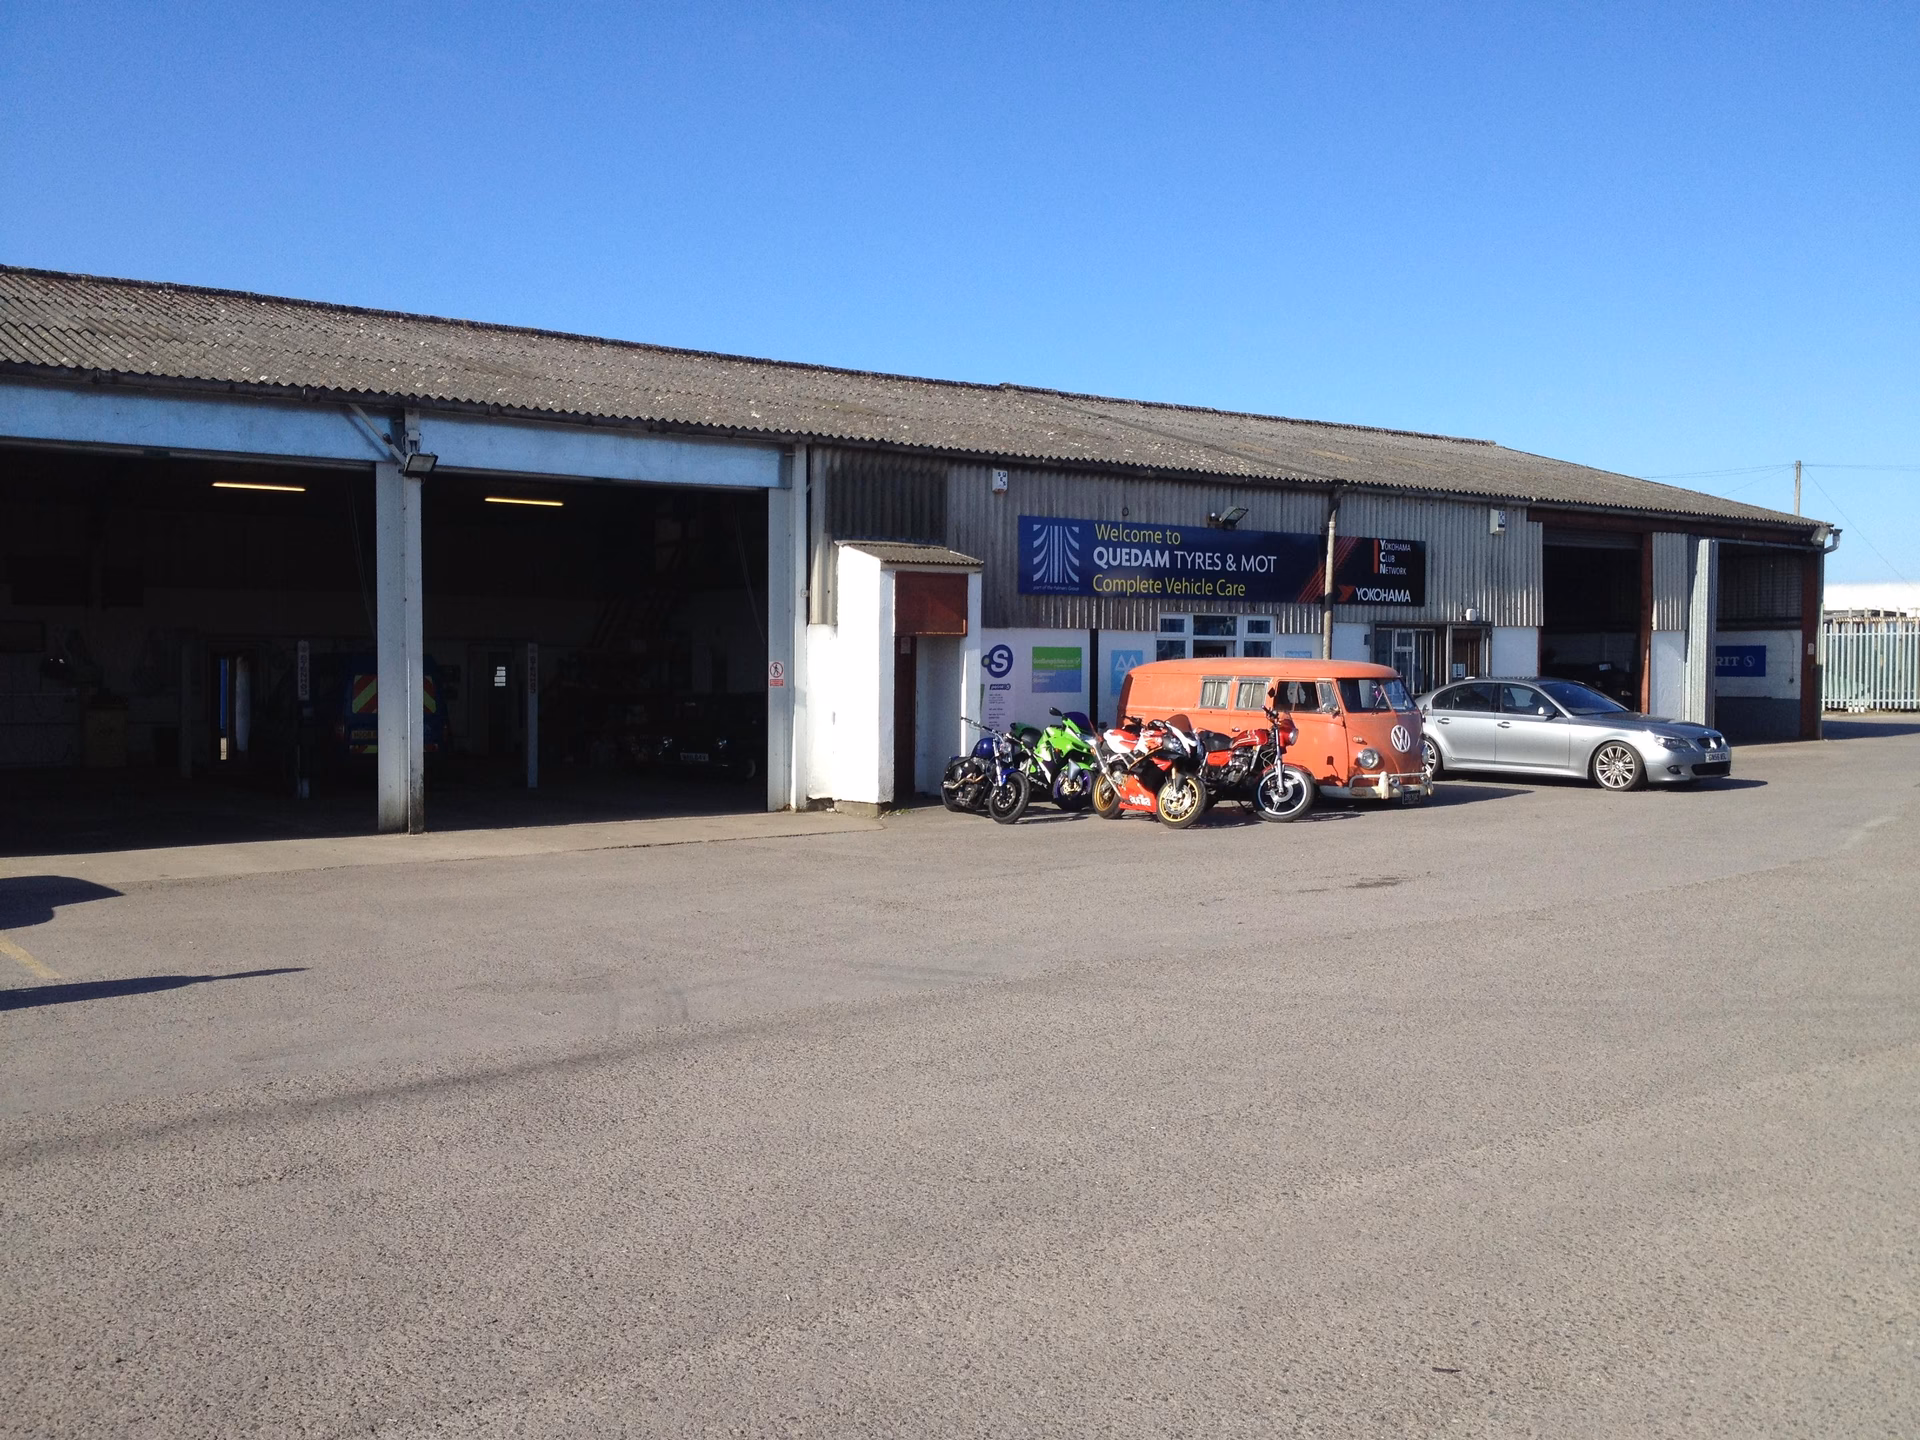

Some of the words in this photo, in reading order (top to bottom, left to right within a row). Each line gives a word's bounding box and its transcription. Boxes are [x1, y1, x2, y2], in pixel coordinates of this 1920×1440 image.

[1095, 523, 1162, 543] Welcome
[1166, 528, 1181, 544] to
[1093, 546, 1170, 568] QUEDAM
[1174, 551, 1221, 571] TYRES
[1226, 554, 1236, 571] &
[1241, 555, 1277, 573] MOT
[1093, 574, 1162, 596] Complete
[1165, 577, 1213, 595] Vehicle
[1216, 579, 1246, 596] Care
[1355, 587, 1411, 602] YOKOHAMA
